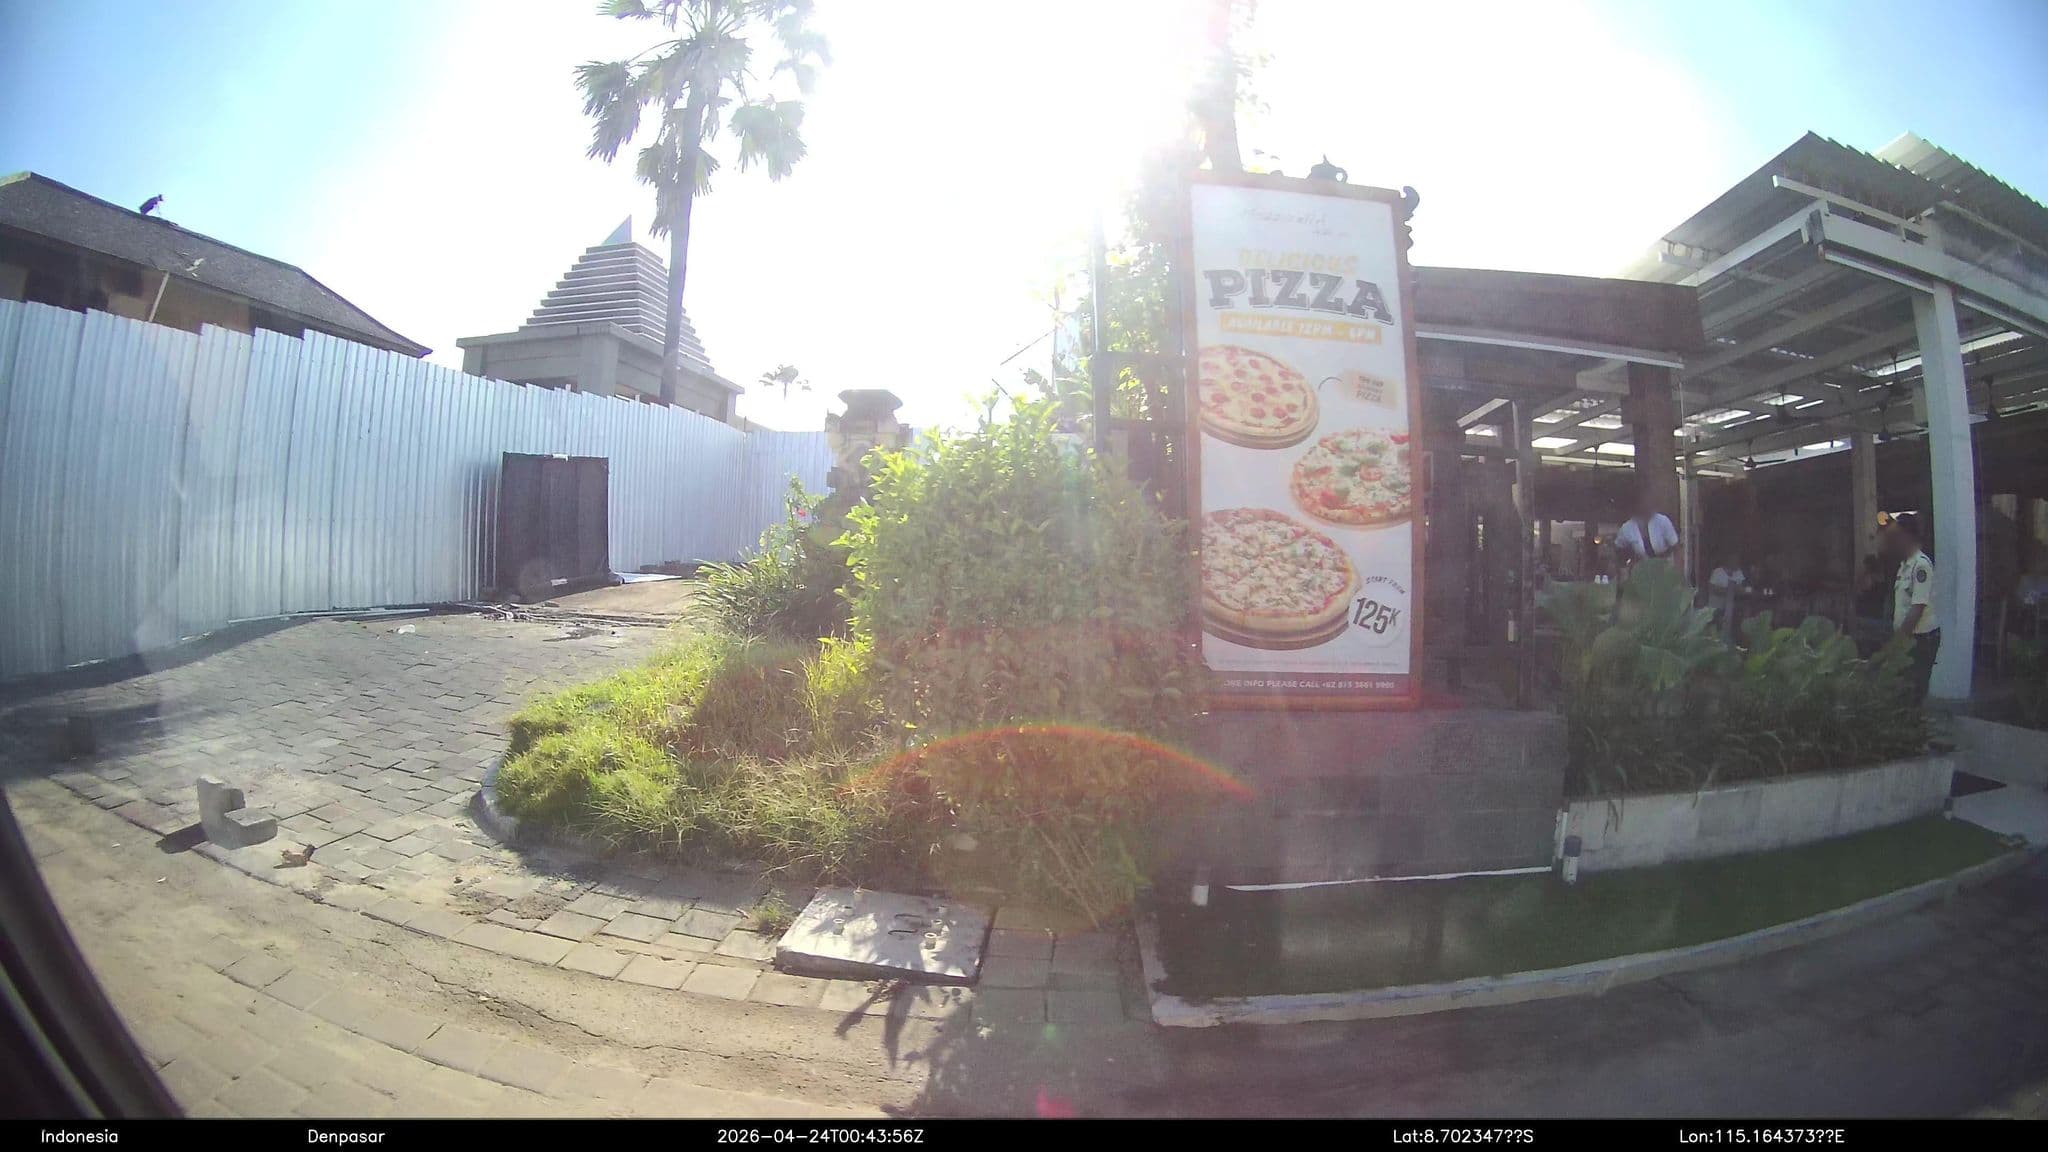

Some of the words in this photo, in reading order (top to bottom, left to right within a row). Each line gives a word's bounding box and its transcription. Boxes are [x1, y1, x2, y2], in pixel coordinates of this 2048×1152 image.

[1203, 268, 1394, 325] PIZZA
[1356, 390, 1382, 402] PIZZA
[1352, 597, 1401, 634] 125K
[1266, 679, 1298, 689] PLEASE
[1299, 680, 1320, 689] CALL
